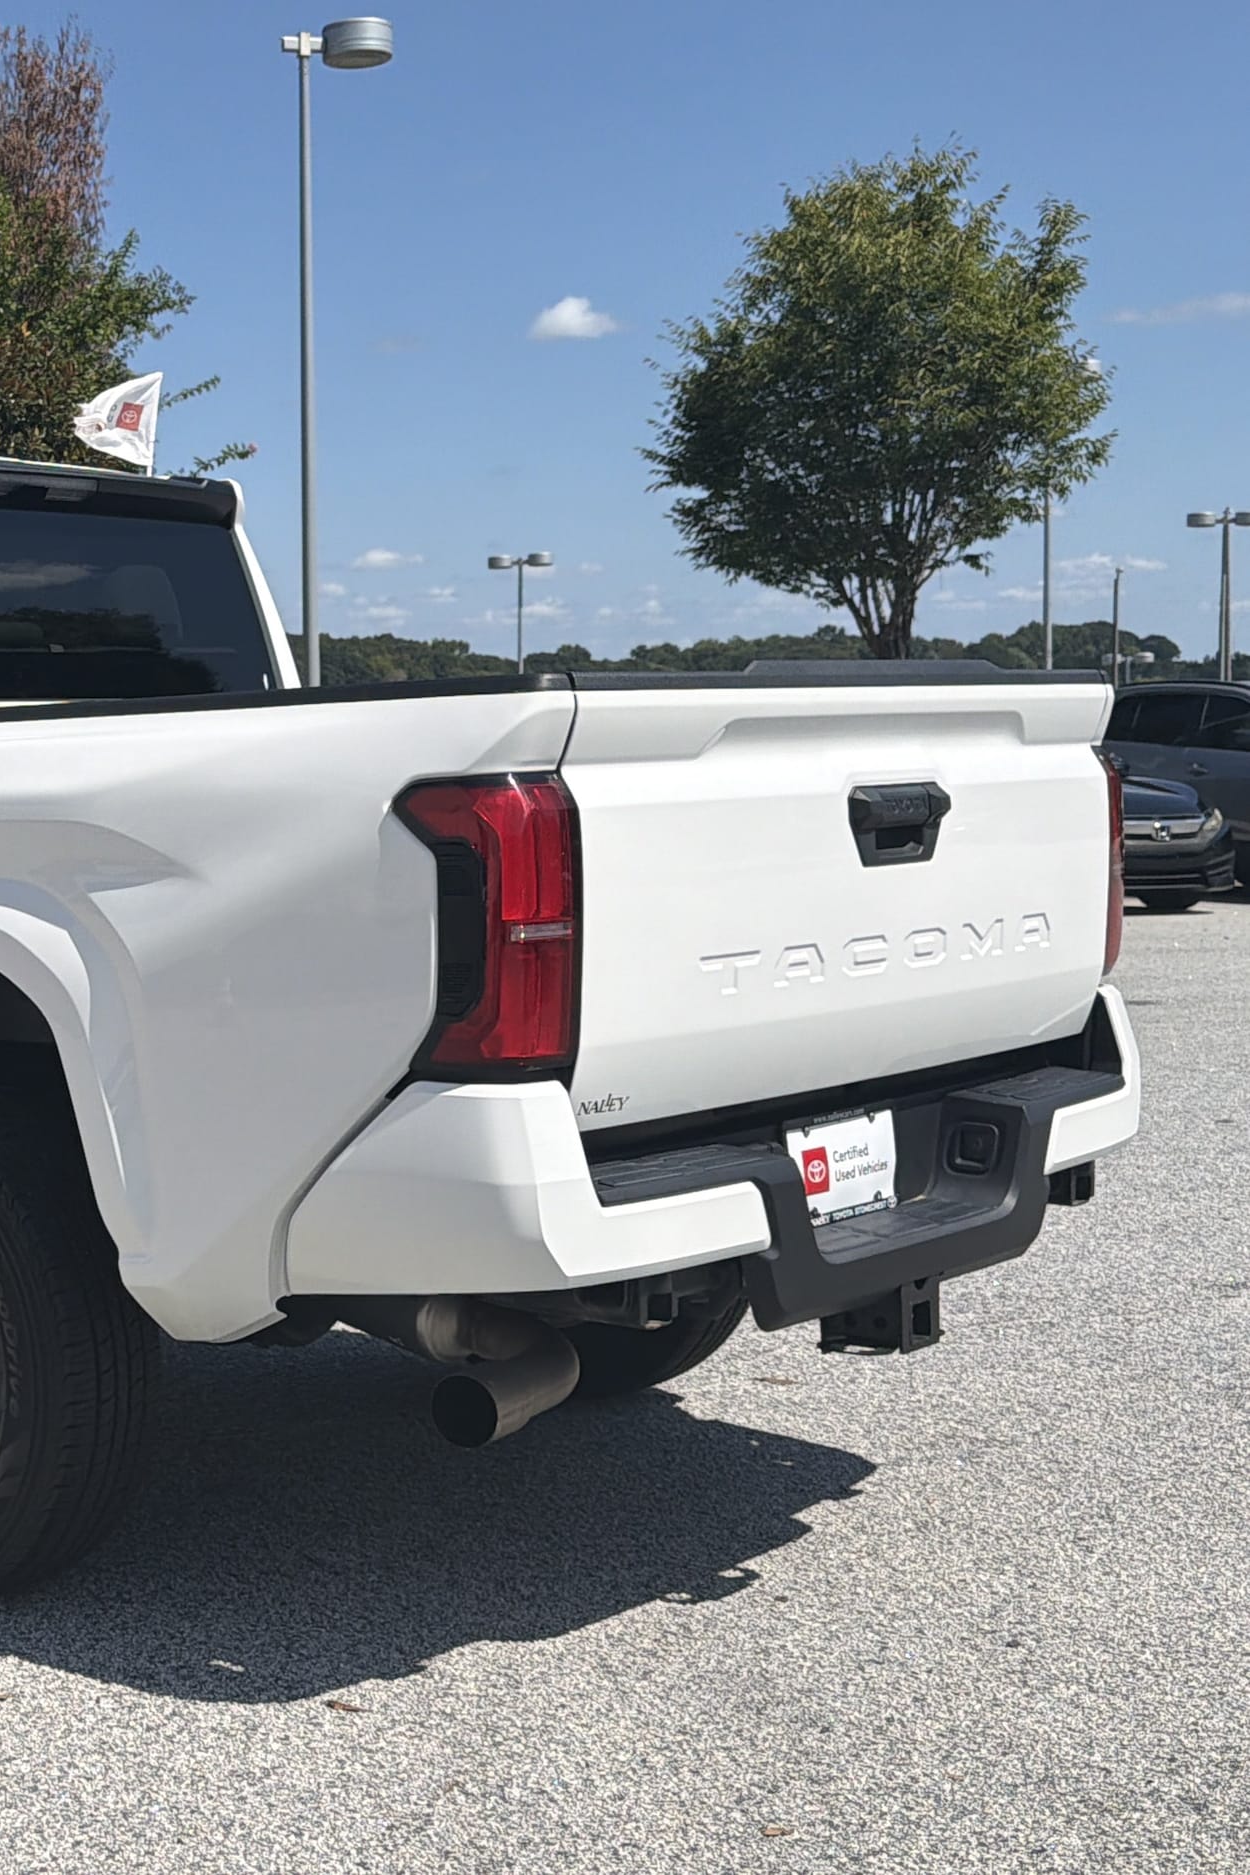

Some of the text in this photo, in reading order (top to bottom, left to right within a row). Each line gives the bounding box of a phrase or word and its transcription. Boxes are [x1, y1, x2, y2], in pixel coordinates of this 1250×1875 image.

[699, 911, 1051, 996] TACOMA
[577, 1092, 630, 1116] NALLEY
[832, 1142, 869, 1163] Certified
[834, 1158, 888, 1182] Used Vehicles
